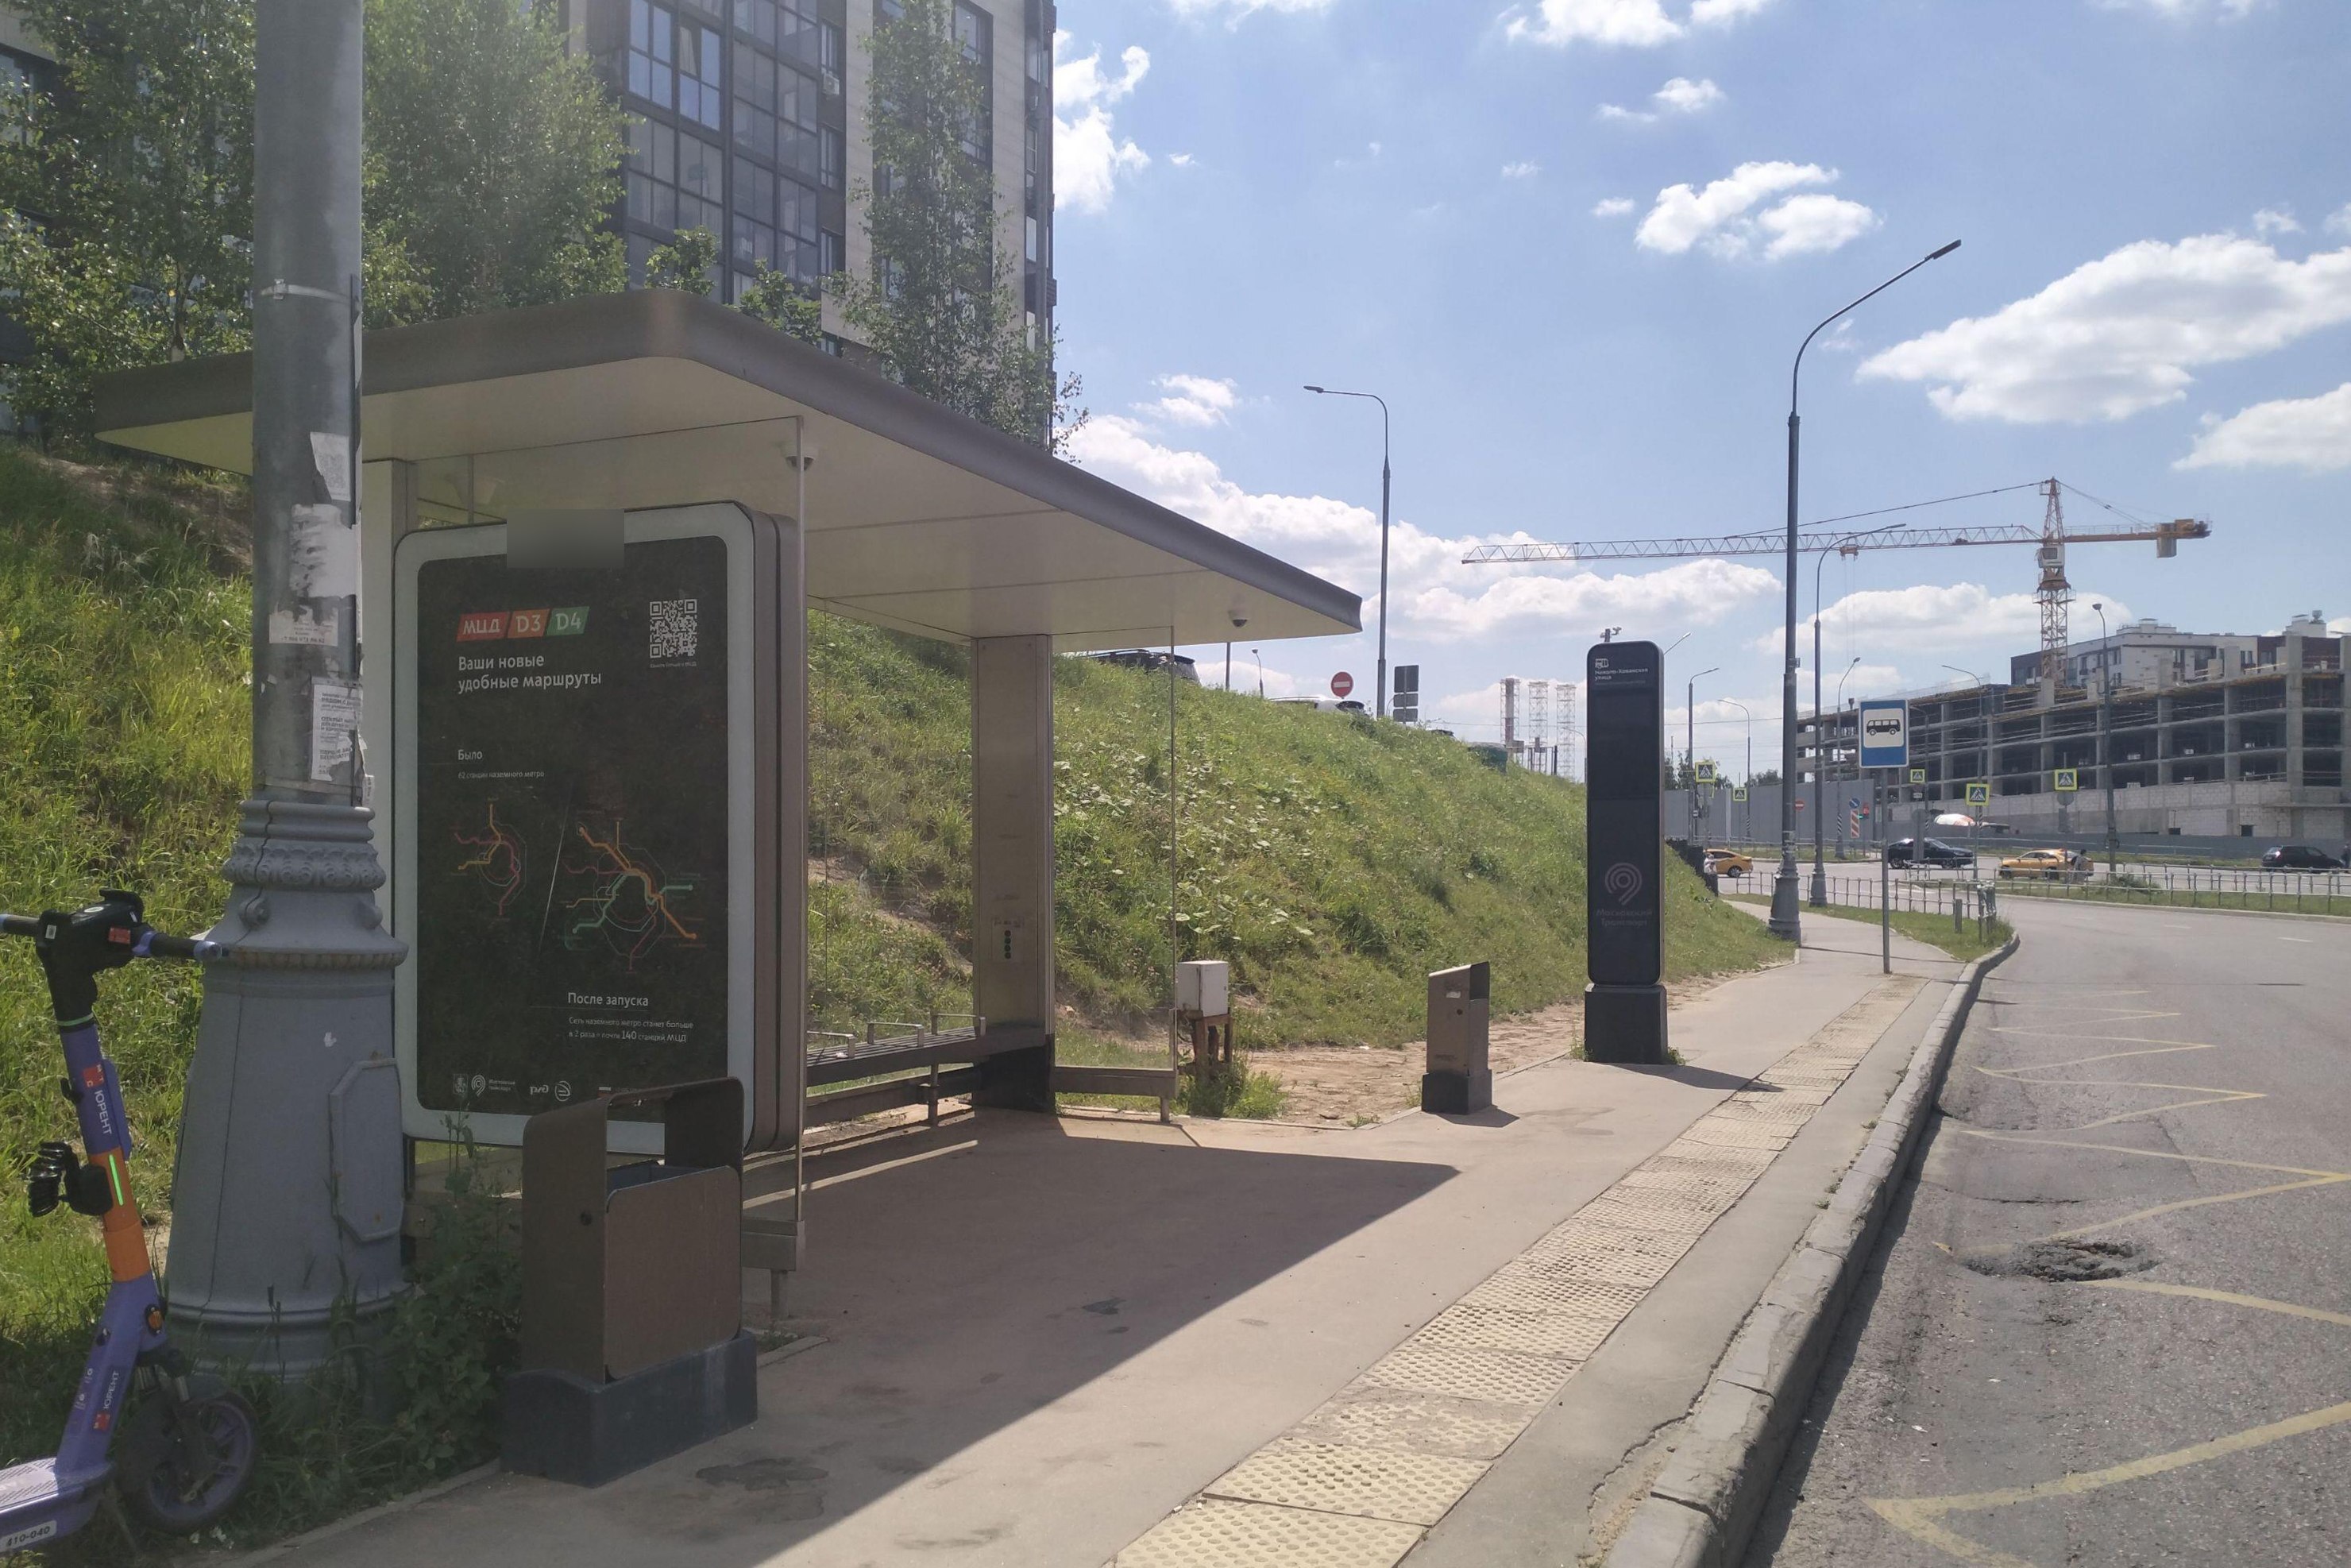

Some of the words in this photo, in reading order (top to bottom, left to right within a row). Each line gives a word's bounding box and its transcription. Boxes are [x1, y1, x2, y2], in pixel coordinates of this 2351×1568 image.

[462, 619, 500, 635] МЦД
[515, 614, 541, 633] D3
[554, 612, 581, 631] D4
[458, 656, 494, 671] Ваши
[499, 655, 545, 669] новые
[458, 674, 519, 694] удобные
[523, 673, 601, 689] маршруты
[457, 749, 483, 760] Было
[568, 992, 603, 1004] После
[606, 996, 649, 1008] запуска
[666, 1020, 693, 1029] больше
[622, 1030, 637, 1040] 140
[638, 1033, 666, 1041] станций
[666, 1034, 687, 1043] МЦД
[94, 1090, 112, 1134] ЮРЕНТ
[103, 1369, 119, 1409] ЮРЕНТ
